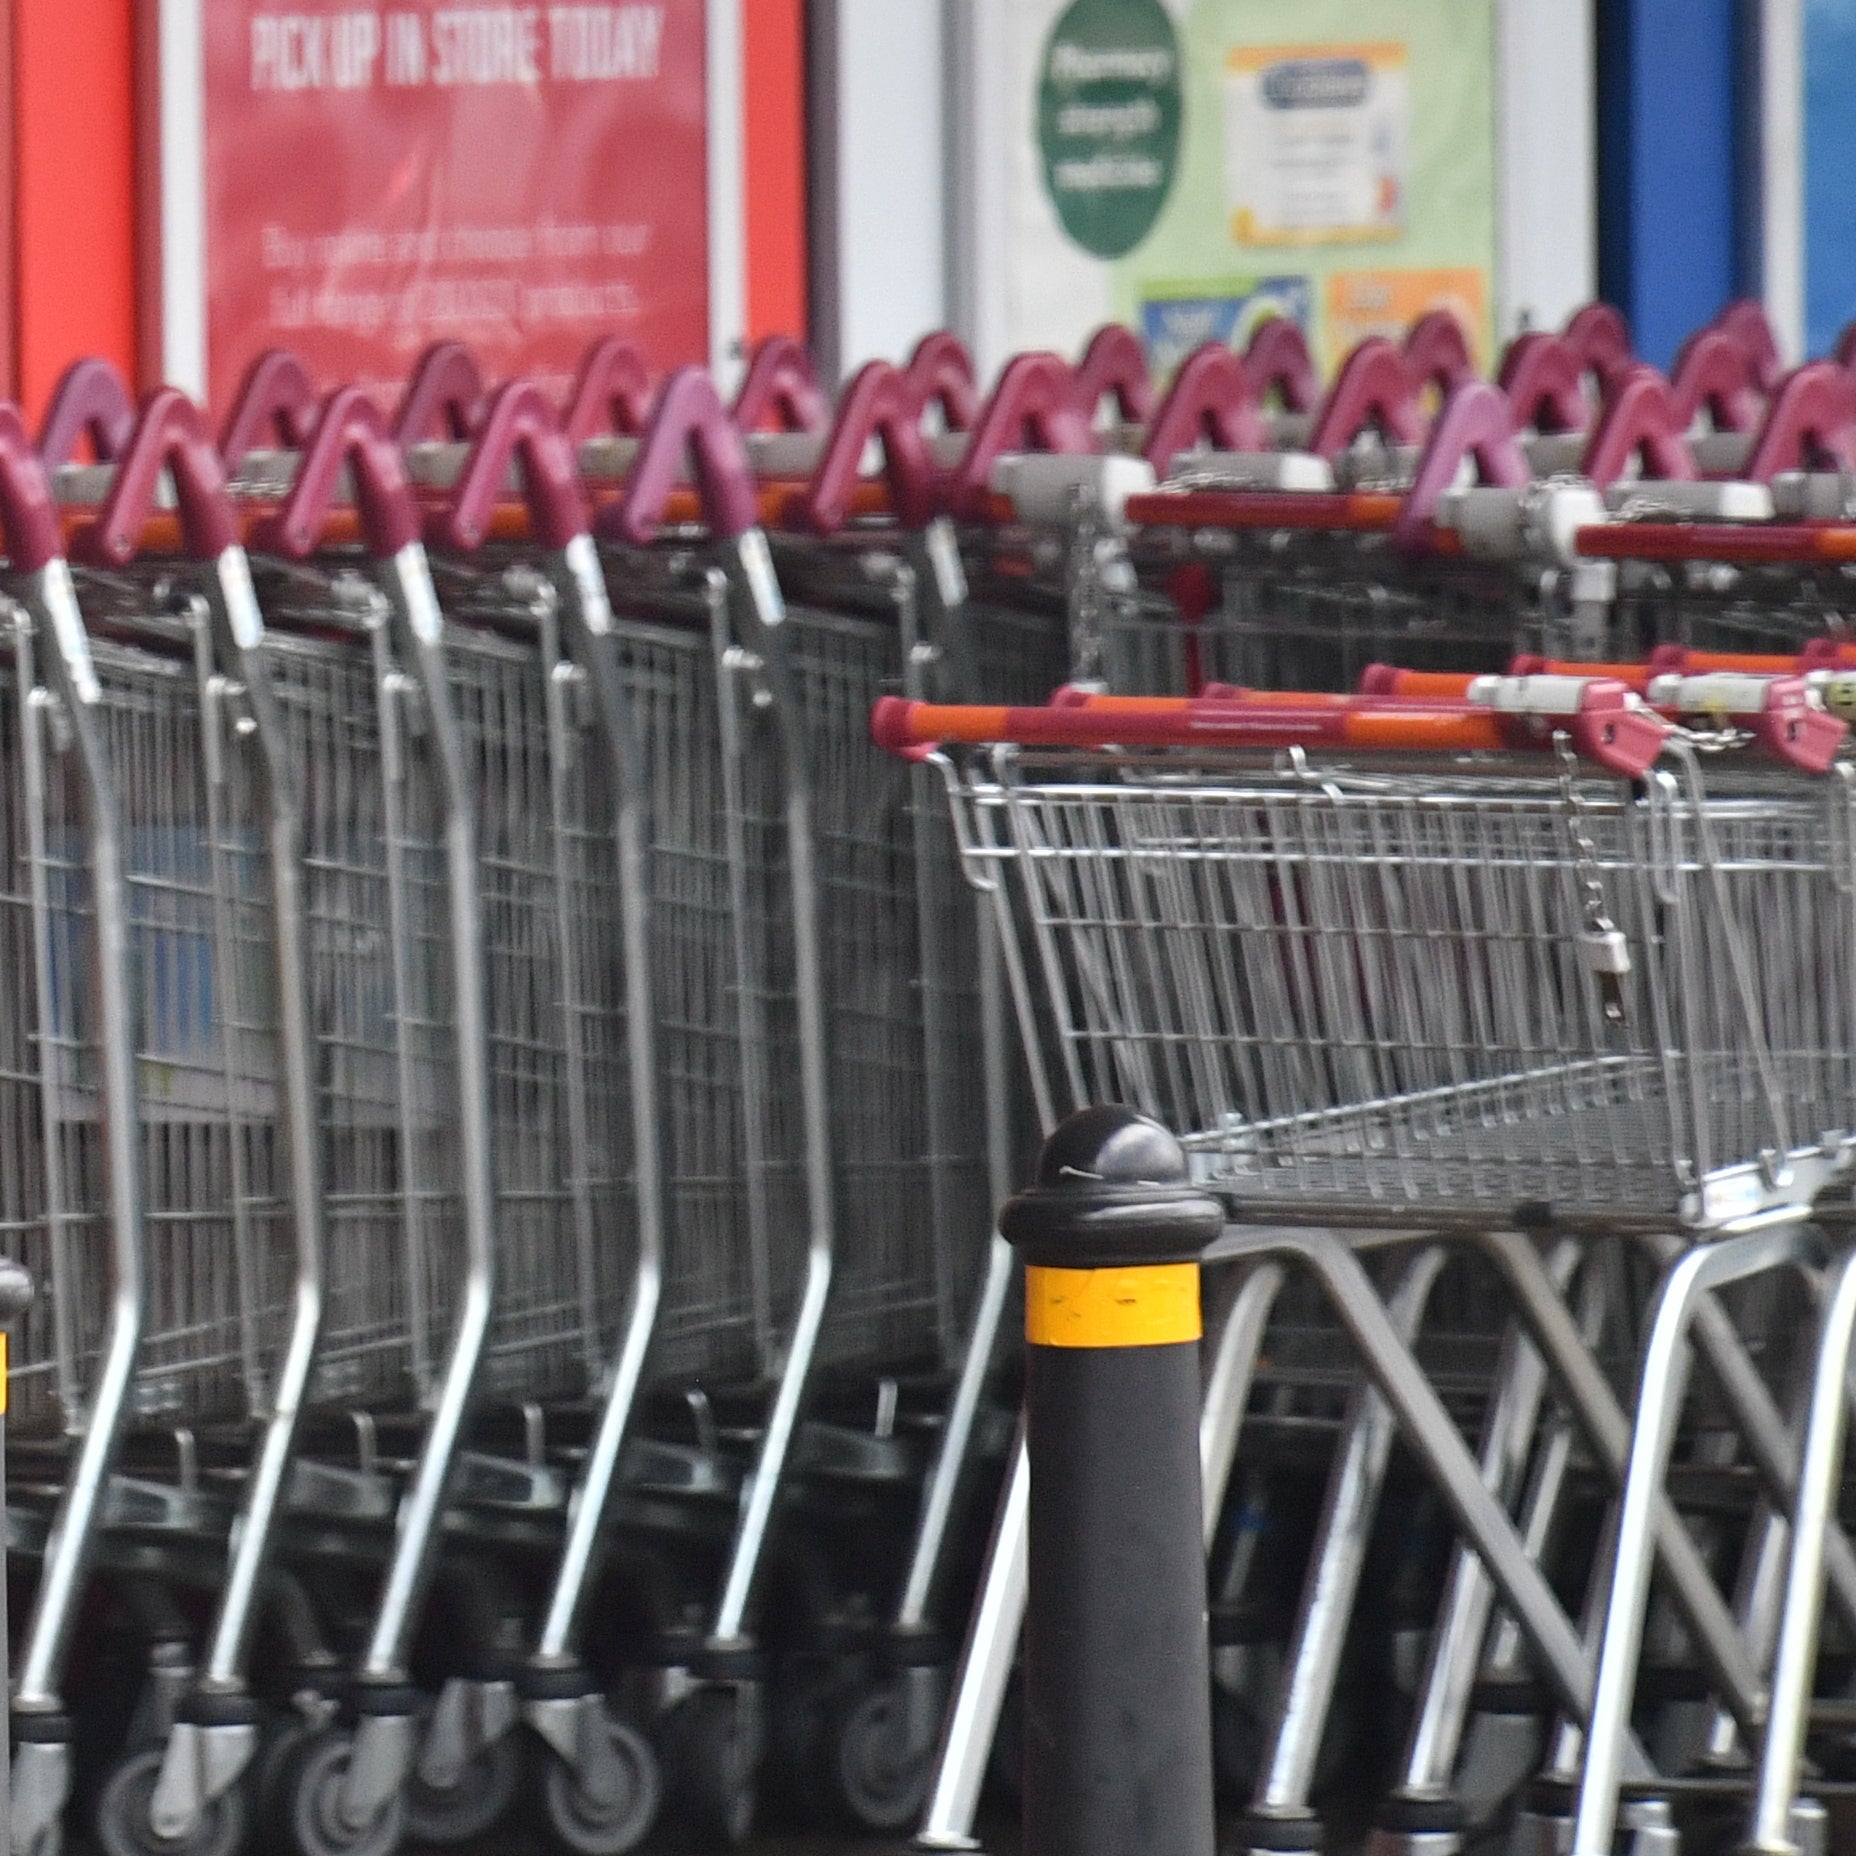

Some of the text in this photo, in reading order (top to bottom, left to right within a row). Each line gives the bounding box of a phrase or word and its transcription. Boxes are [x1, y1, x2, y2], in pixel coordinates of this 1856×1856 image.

[250, 2, 664, 91] PICK UP IN STORE TODAY
